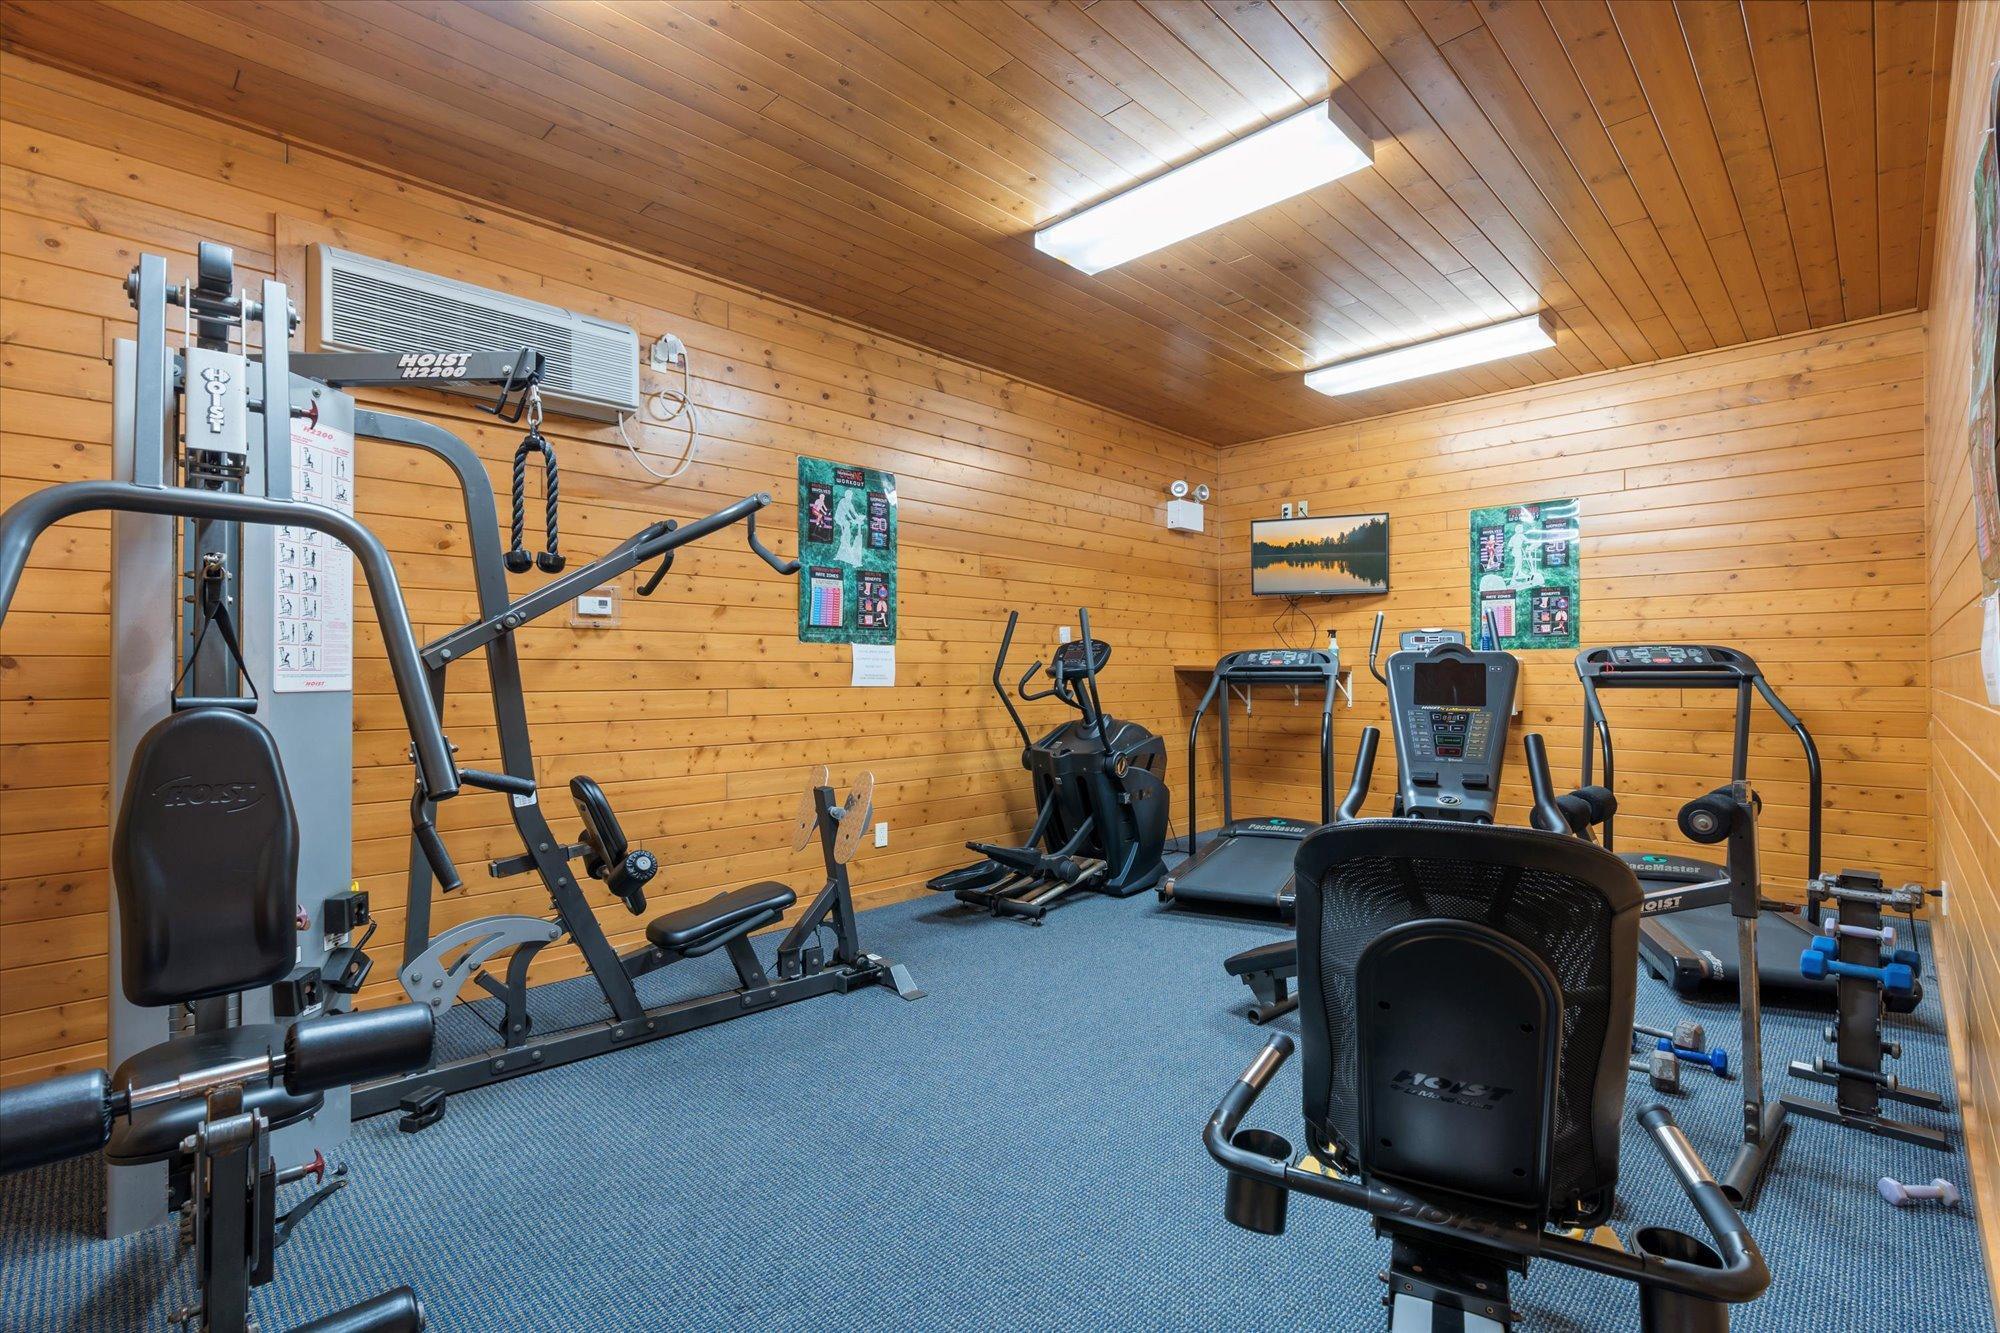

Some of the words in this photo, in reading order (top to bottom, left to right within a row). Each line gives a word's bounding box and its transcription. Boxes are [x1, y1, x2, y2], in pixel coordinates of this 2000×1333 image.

[397, 353, 472, 367] HOIST
[401, 366, 467, 378] H2200
[201, 368, 231, 433] HOIST
[836, 478, 864, 487] WORKOUT
[164, 782, 257, 807] HOIST
[1248, 823, 1306, 833] PaceMaster
[1626, 862, 1701, 874] aceMaster
[1392, 1069, 1515, 1101] HOIST
